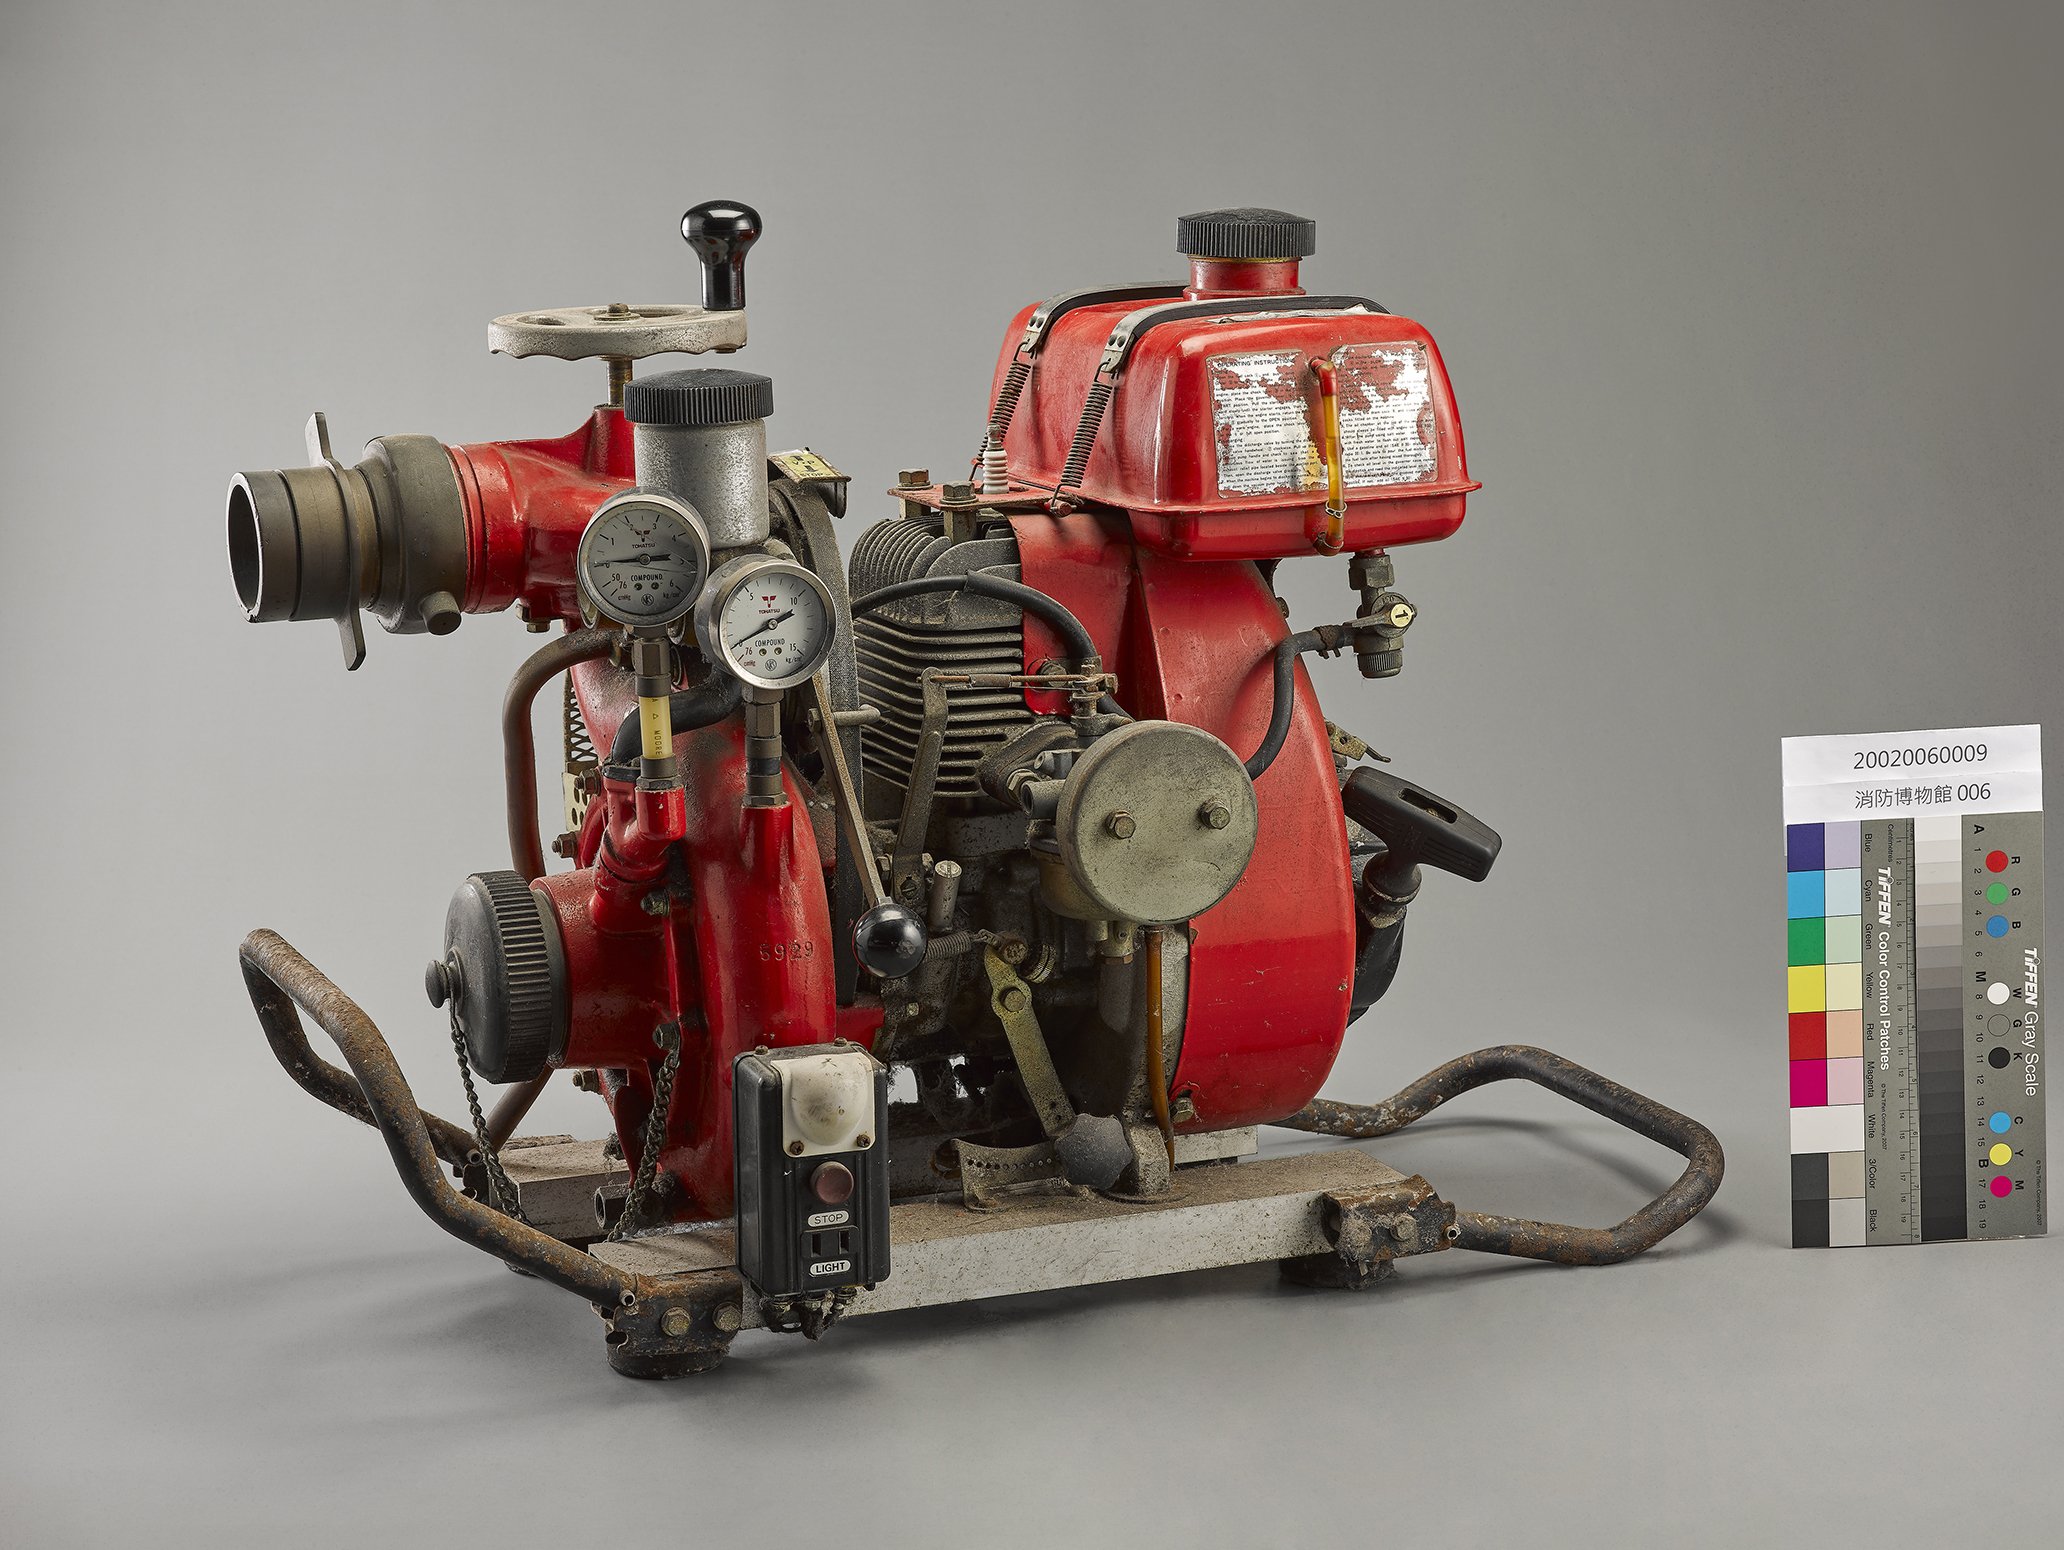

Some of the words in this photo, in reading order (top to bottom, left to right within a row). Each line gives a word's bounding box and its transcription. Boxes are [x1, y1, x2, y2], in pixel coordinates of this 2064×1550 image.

[611, 538, 615, 546] 1
[612, 573, 621, 581] 50
[631, 574, 663, 582] COMPOUND
[619, 581, 628, 589] 76
[750, 593, 754, 601] 5
[791, 597, 798, 605] 10
[1395, 610, 1409, 619] 1
[755, 639, 785, 647] COMPOUND
[790, 643, 797, 652] 15
[746, 647, 752, 656] 76
[1854, 744, 1988, 770] 20020060009
[1855, 785, 1953, 809] 消防博物館
[1958, 783, 1991, 801] 006
[1974, 825, 1985, 835] A
[1865, 834, 1873, 853] Blue
[2011, 856, 2021, 865] R
[1864, 880, 1873, 902] Cyan
[2012, 888, 2021, 897] G
[2012, 921, 2021, 929] B
[1865, 924, 1873, 950] Green
[760, 941, 814, 961] 5929
[1879, 932, 1890, 967] Color
[1976, 971, 1986, 983] M
[1866, 972, 1874, 999] Yellow
[1880, 970, 1891, 1016] Control
[2013, 988, 2022, 999] W
[2013, 1020, 2022, 1028] G
[2022, 1011, 2039, 1048] Gray
[1976, 1033, 1983, 1043] 10
[1880, 1021, 1891, 1071] Patches
[1977, 1055, 1984, 1063] 11
[2014, 1053, 2022, 1061] K
[1866, 1062, 1875, 1098] Magenta
[1977, 1075, 1984, 1085] 12
[2025, 1053, 2039, 1097] Scale
[1977, 1097, 1984, 1107] 13
[1978, 1118, 1985, 1127] 14
[2015, 1117, 2024, 1125] C
[1868, 1114, 1876, 1139] White
[1978, 1138, 1985, 1147] 15
[2015, 1149, 2024, 1157] Y
[1979, 1159, 1989, 1169] B
[1869, 1159, 1877, 1189] 3/Color
[1979, 1179, 1986, 1188] 17
[2016, 1181, 2024, 1190] M
[1979, 1200, 1986, 1210] 18
[814, 1214, 844, 1225] STOP
[1979, 1220, 1987, 1229] 19
[816, 1262, 846, 1273] LIGHT
